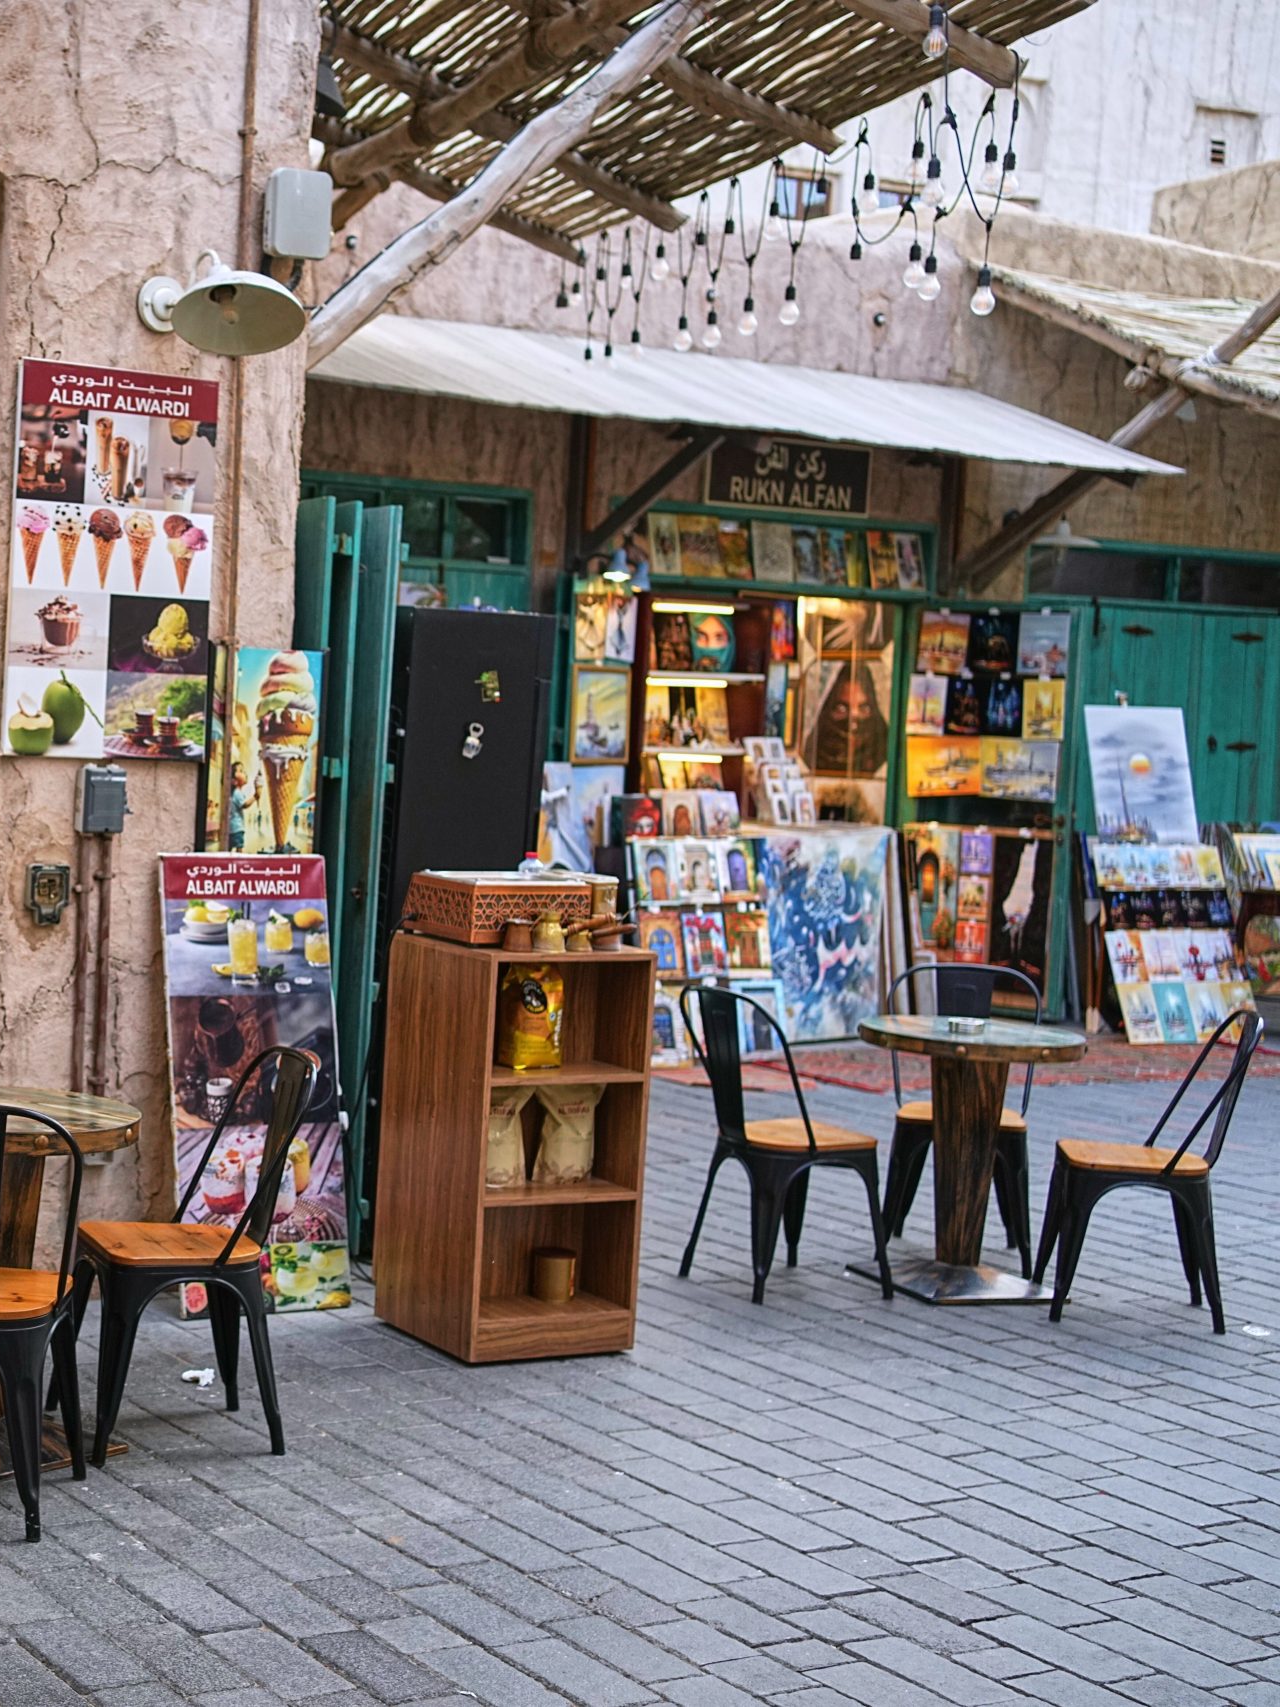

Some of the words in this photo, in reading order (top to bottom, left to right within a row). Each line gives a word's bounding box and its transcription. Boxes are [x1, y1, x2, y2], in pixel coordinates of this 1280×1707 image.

[51, 373, 113, 387] الوردي
[117, 379, 193, 396] البيت
[49, 388, 112, 408] ALBAIT
[114, 398, 190, 417] ALWARDI
[794, 450, 827, 481] ركن
[730, 476, 785, 505] RUKN
[788, 481, 852, 511] ALFAN
[186, 863, 237, 878] الوردي
[240, 864, 301, 877] البيت
[186, 880, 236, 895] ALBAIT
[238, 880, 300, 895] ALWARDI
